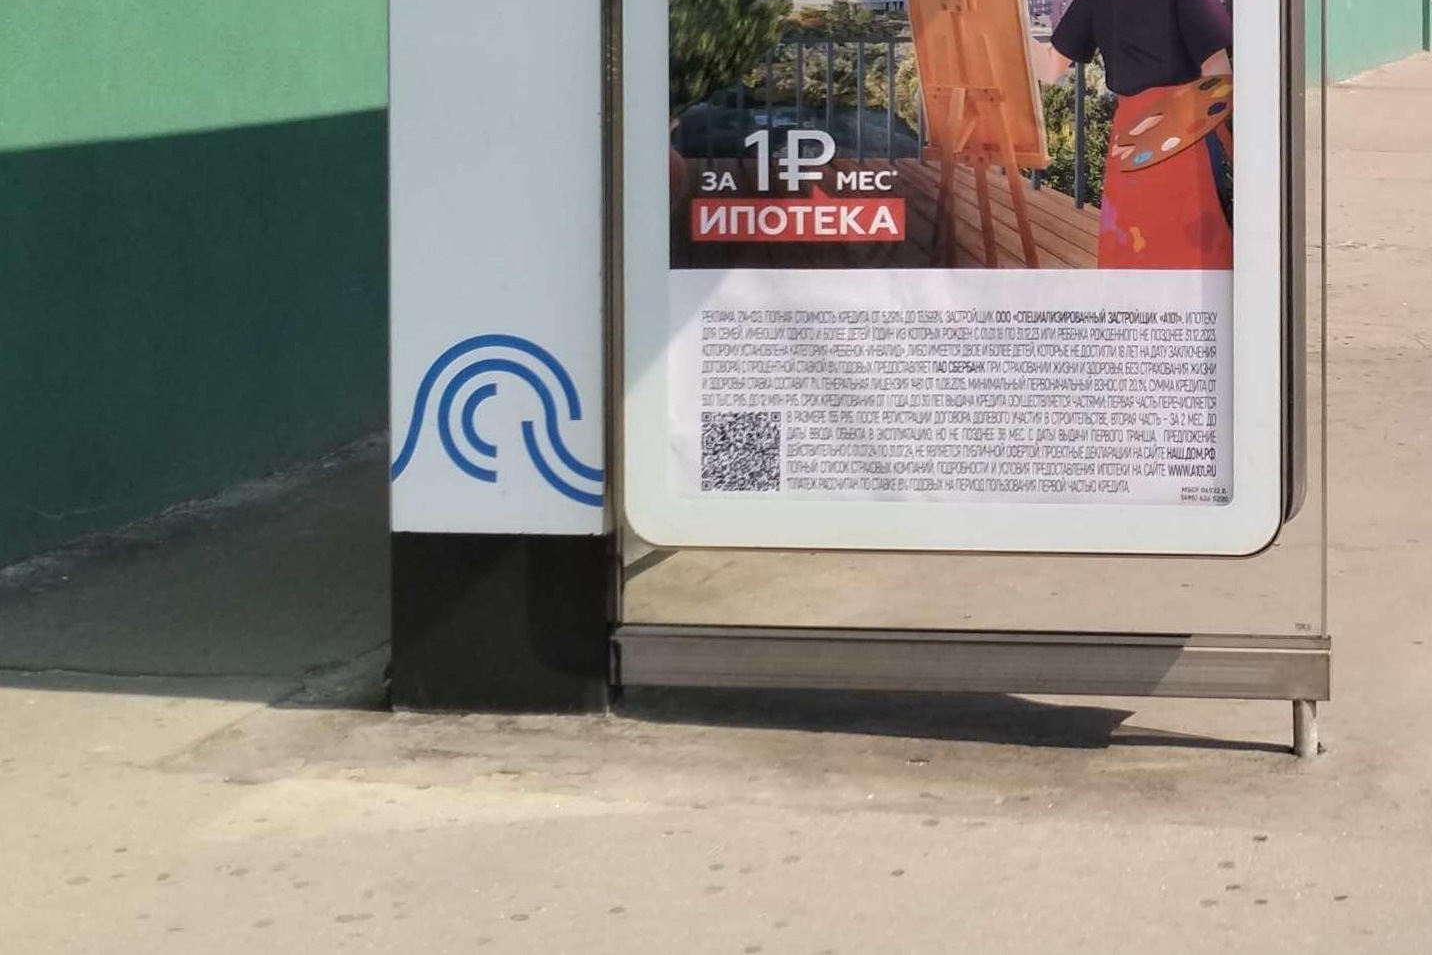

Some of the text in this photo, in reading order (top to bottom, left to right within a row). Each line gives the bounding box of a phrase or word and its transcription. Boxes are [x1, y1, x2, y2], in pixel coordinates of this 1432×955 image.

[702, 172, 736, 192] ЗА
[700, 206, 898, 236] ИПОТЕКА
[996, 312, 1011, 324] ООО
[1108, 310, 1158, 324] ЗАСТРОЙЩИК
